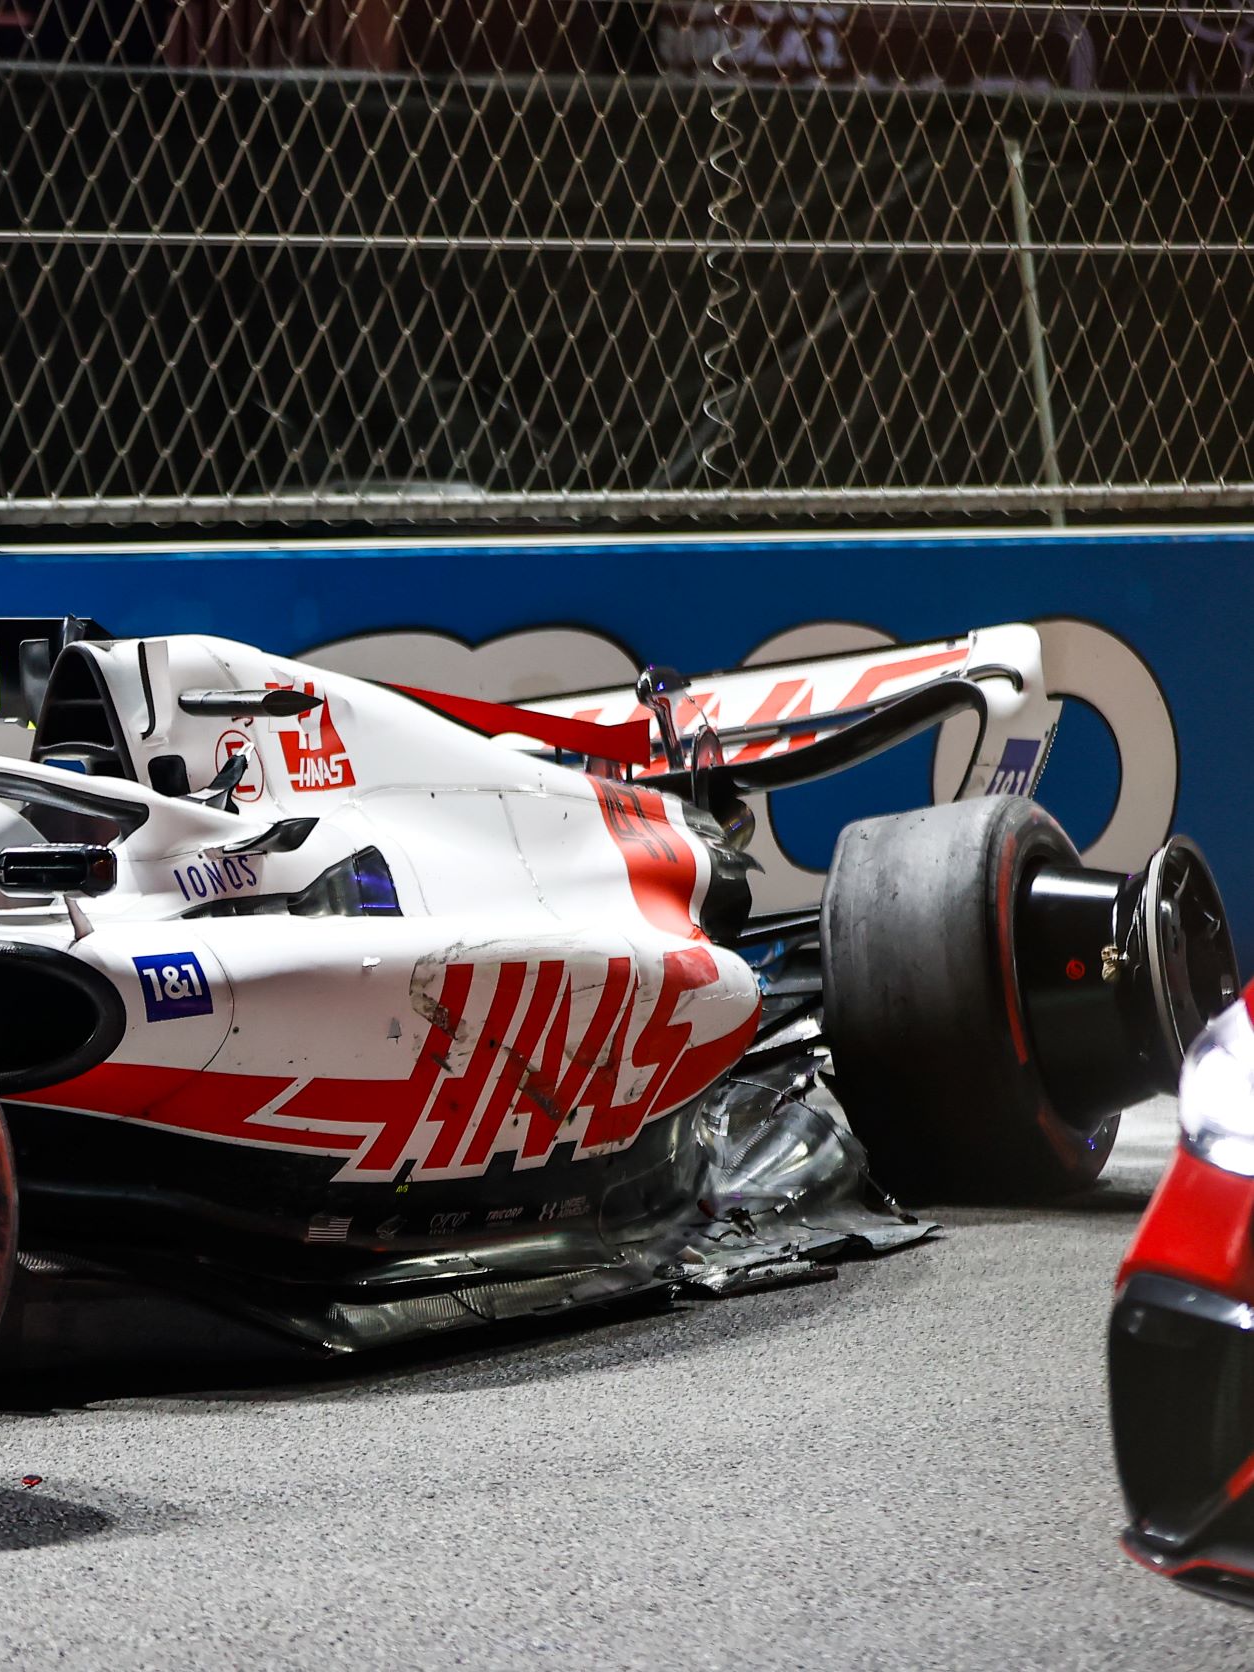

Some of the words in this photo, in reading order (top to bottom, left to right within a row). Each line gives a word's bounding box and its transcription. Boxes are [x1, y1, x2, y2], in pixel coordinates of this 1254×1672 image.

[290, 752, 348, 788] HAAS
[173, 856, 258, 901] IONOS
[143, 963, 207, 1002] 1&1
[334, 945, 761, 1181] HAAS
